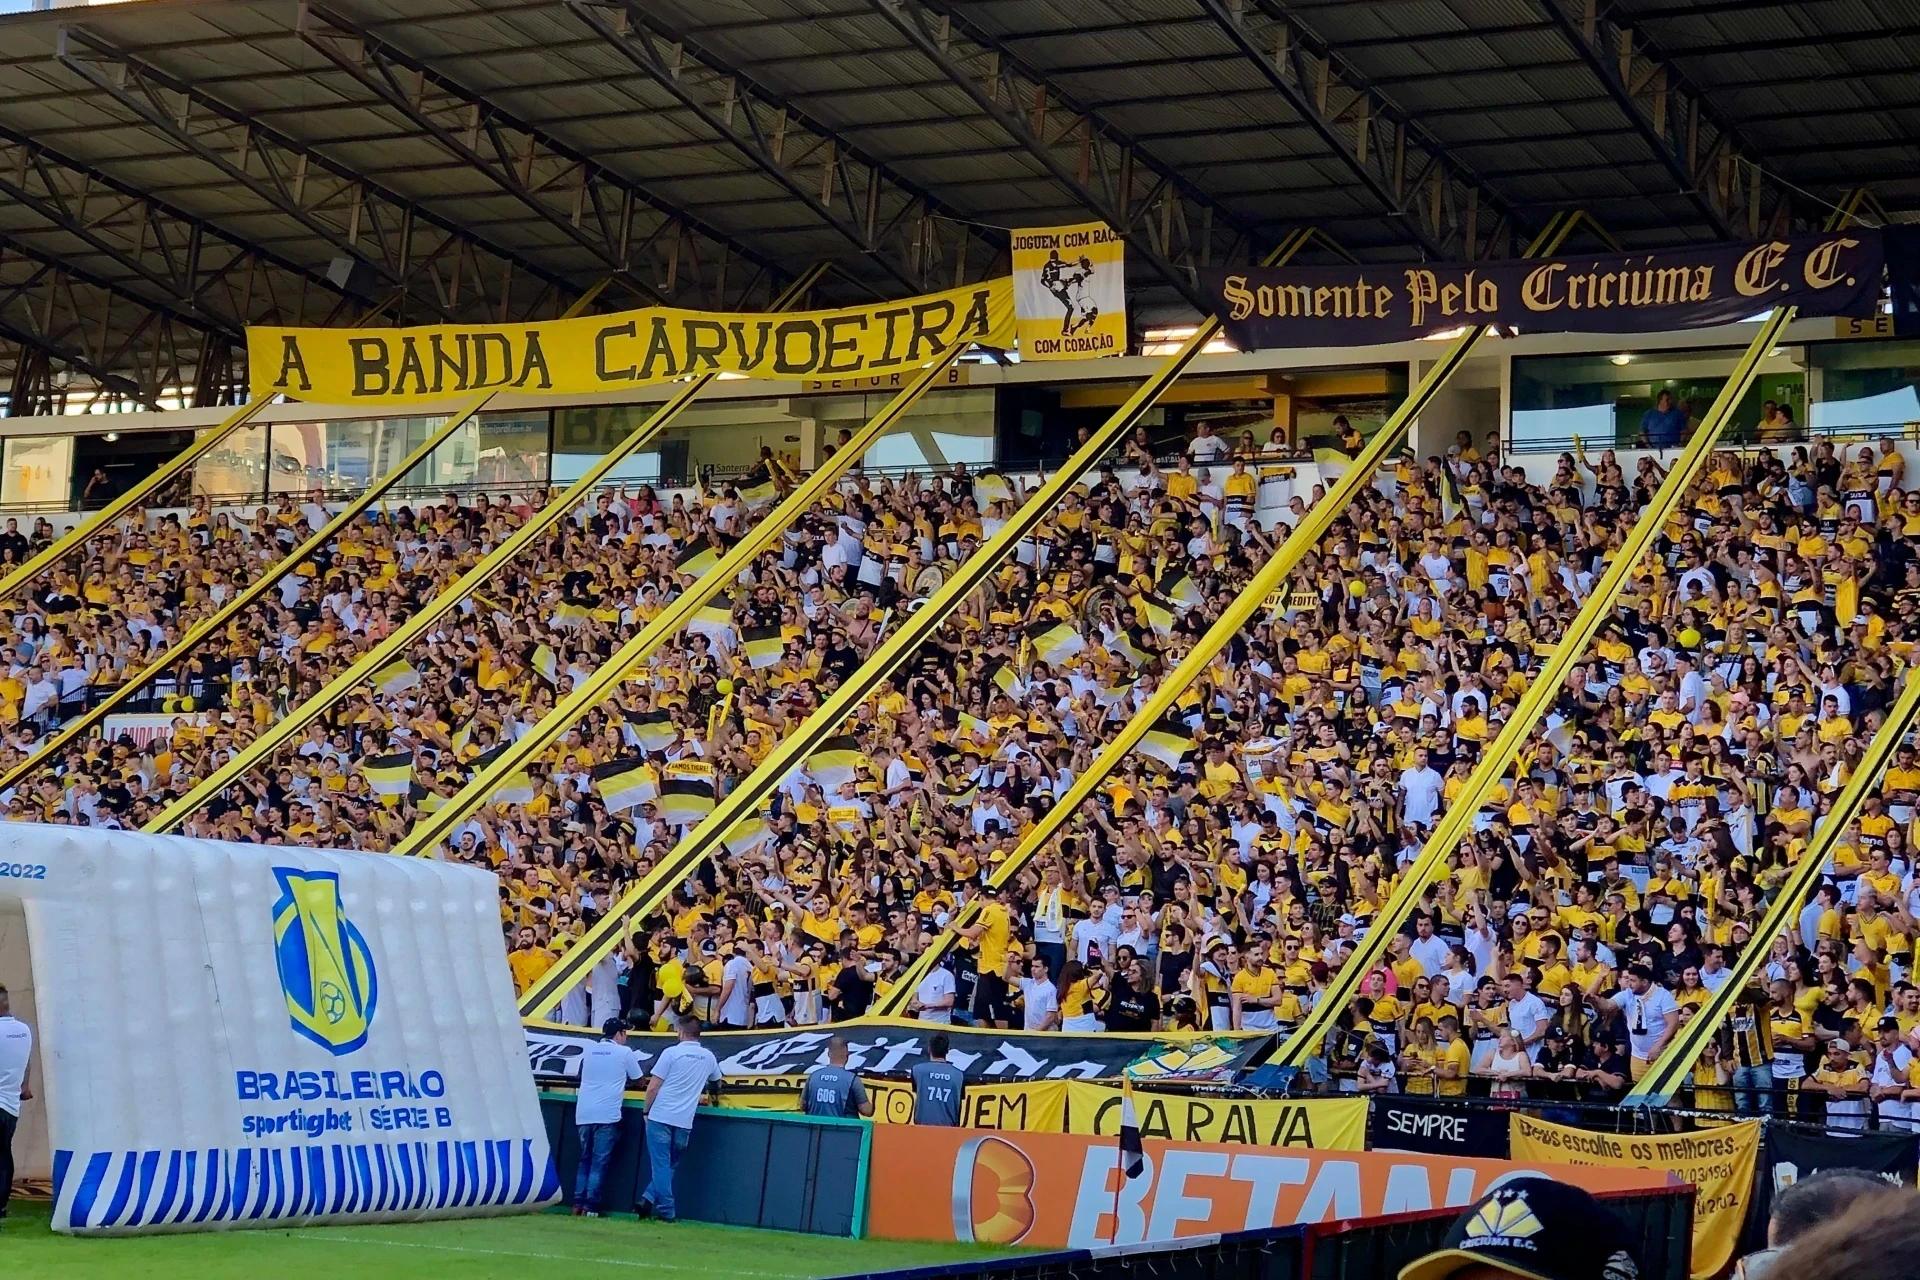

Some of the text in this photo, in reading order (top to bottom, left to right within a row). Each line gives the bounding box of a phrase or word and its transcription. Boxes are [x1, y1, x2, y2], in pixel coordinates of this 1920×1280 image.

[1013, 231, 1061, 251] JOGUEM
[1064, 230, 1092, 248] COM
[1223, 275, 1394, 321] Somente
[1404, 269, 1498, 327] Pelo
[1521, 256, 1715, 311] Criciúma
[273, 290, 990, 397] A BANDA CARVOEIRA
[1035, 335, 1114, 354] COM CORAÇÃO
[949, 369, 959, 383] B
[0, 862, 47, 880] 2022
[820, 1074, 838, 1082] FOTO
[929, 1072, 951, 1081] FOTO
[816, 1087, 836, 1104] 606
[927, 1086, 952, 1103] 747
[435, 1106, 452, 1128] B
[1386, 1109, 1468, 1142] SEMPRE
[1519, 1118, 1561, 1148] Deus
[1562, 1134, 1623, 1160] escolhe
[1630, 1143, 1653, 1161] os
[1067, 1144, 1553, 1249] BETAN
